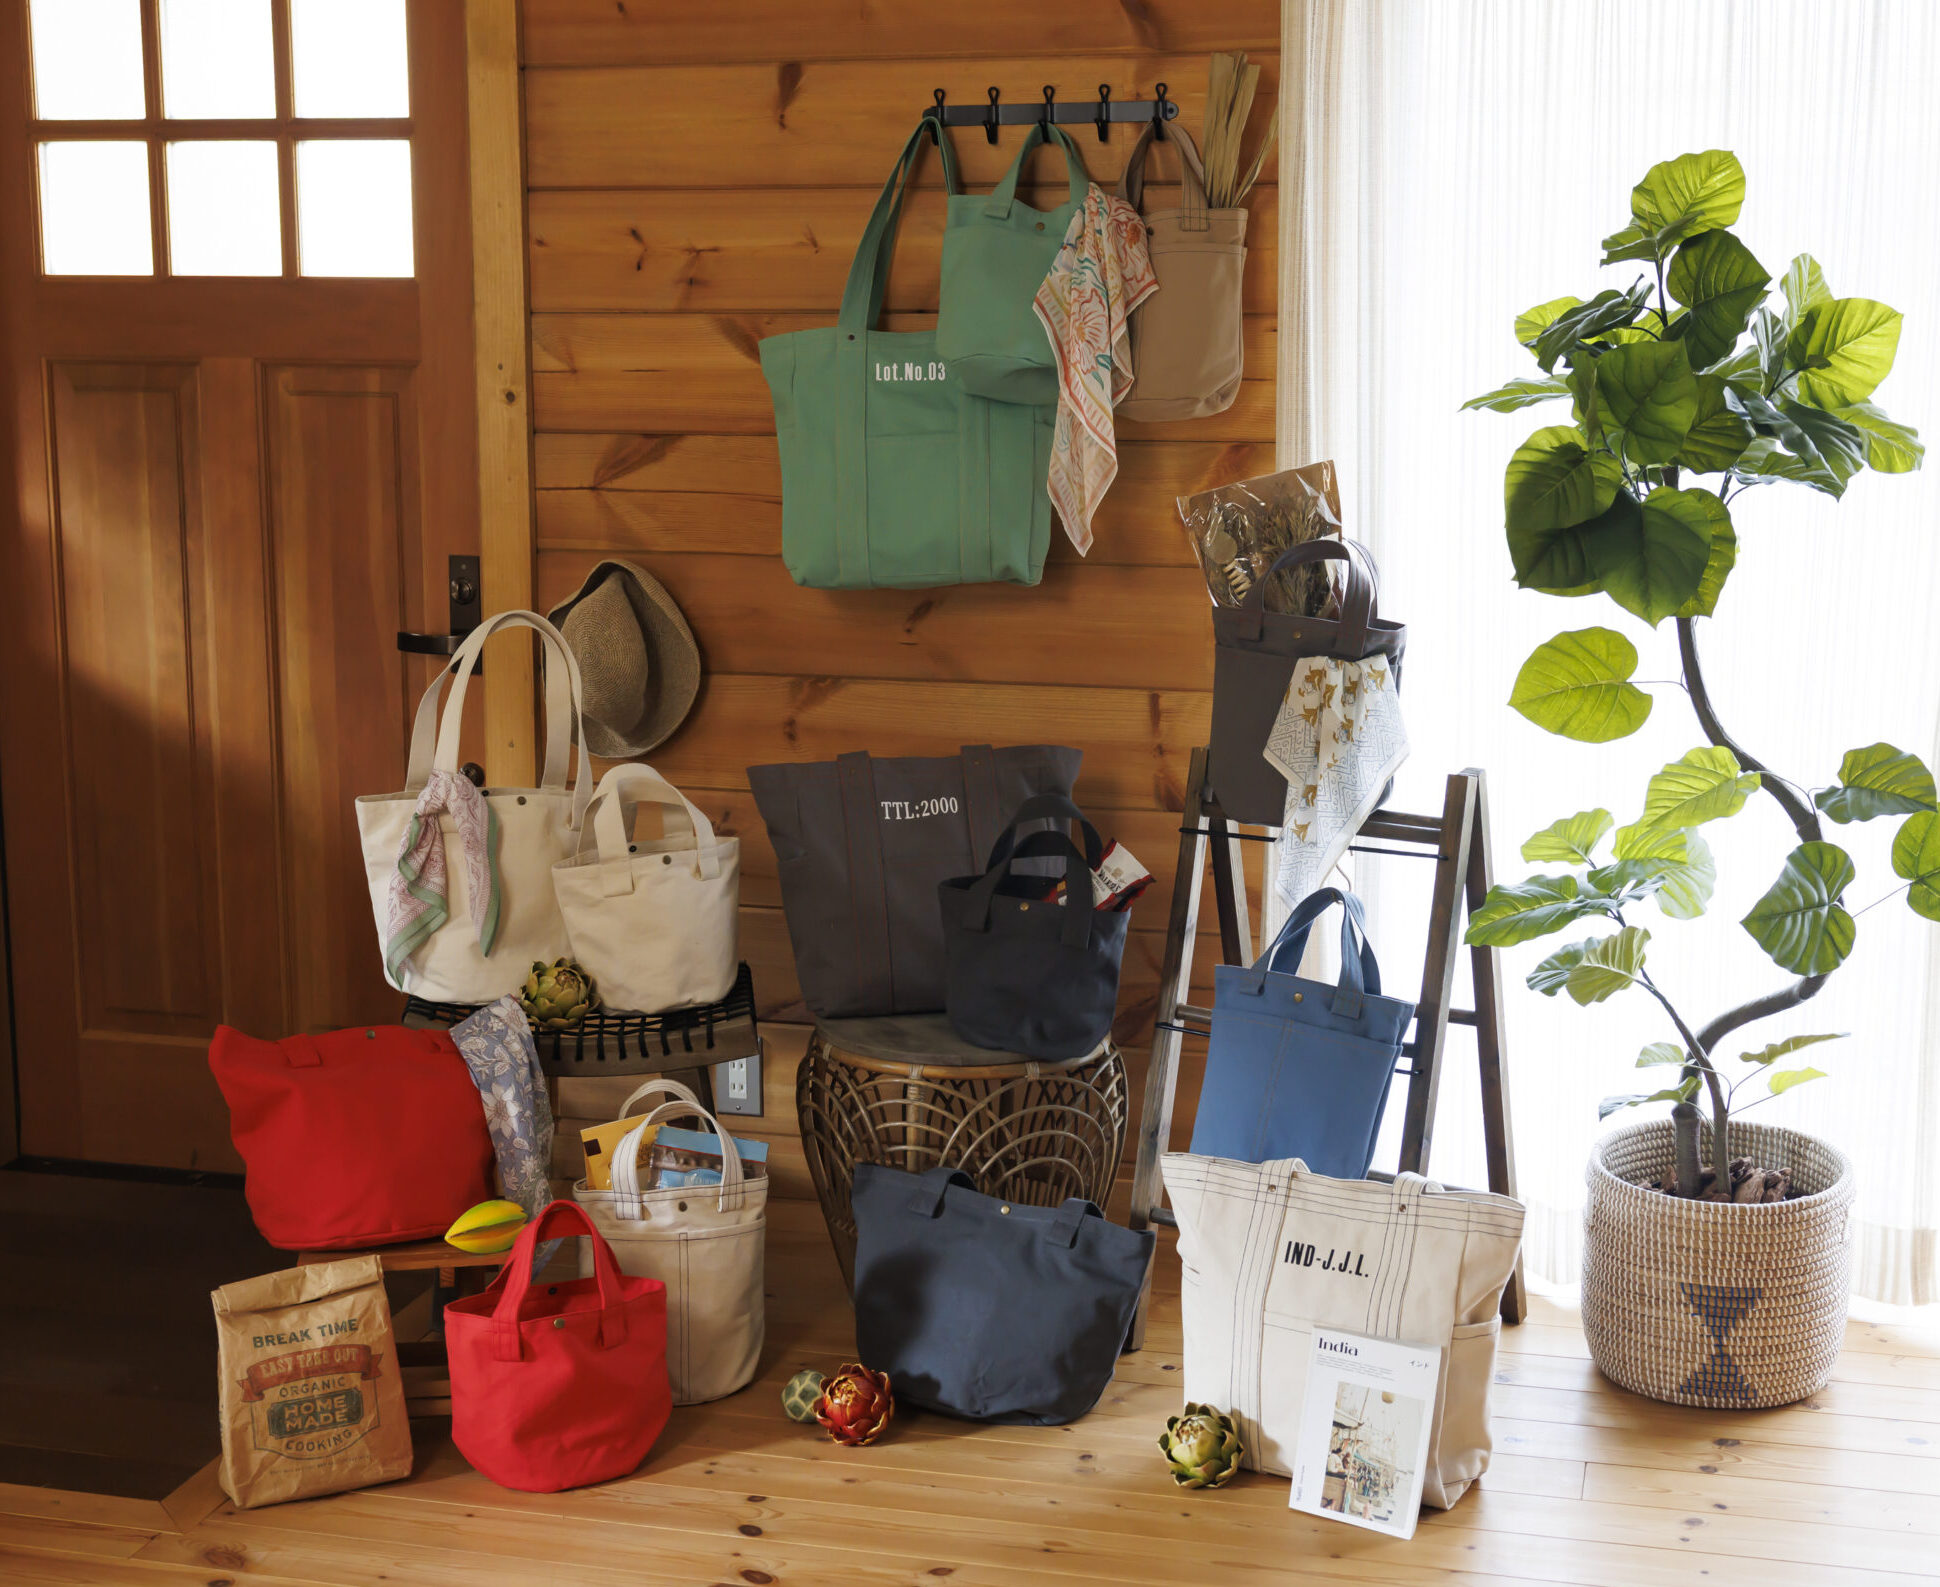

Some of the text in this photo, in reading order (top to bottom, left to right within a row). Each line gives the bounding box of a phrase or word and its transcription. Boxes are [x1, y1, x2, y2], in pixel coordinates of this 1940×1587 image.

[875, 361, 946, 382] Lot.No.03
[880, 796, 959, 820] TTL:2000
[1284, 1240, 1369, 1278] IND-J.J.L.
[252, 1318, 359, 1349] BREAK TIME
[1318, 1337, 1359, 1357] India
[260, 1356, 294, 1378] EASY
[333, 1347, 359, 1363] OUT
[1409, 1360, 1429, 1369] インド
[279, 1375, 347, 1398] ORGANIC
[284, 1394, 347, 1418] HOME
[284, 1408, 348, 1432] MADE
[284, 1429, 353, 1452] COOKING
